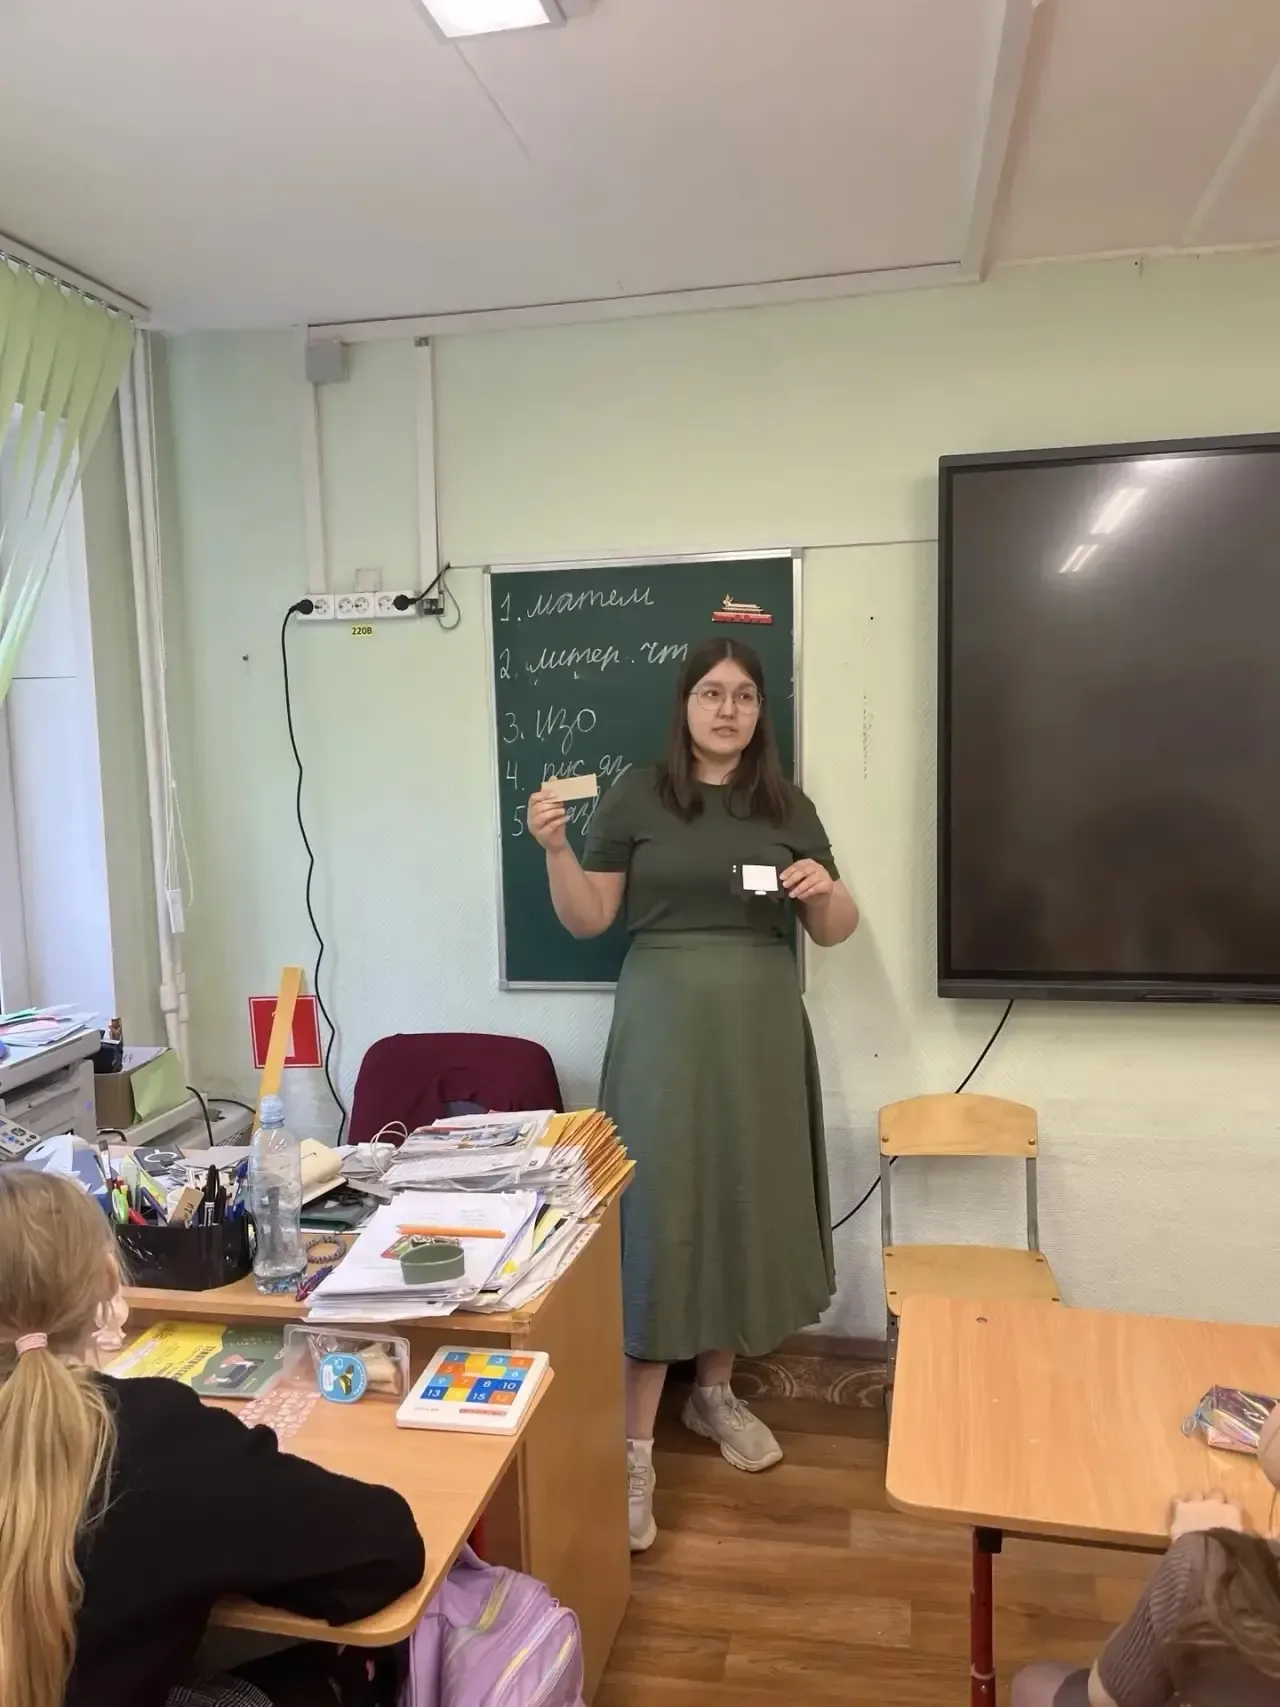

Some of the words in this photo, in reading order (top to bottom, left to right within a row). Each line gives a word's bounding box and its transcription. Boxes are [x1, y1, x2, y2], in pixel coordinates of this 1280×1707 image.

[500, 593, 522, 622] 1.
[526, 587, 655, 618] матем
[351, 626, 373, 636] 220В
[503, 711, 525, 744] 3.
[506, 762, 526, 791] 4.
[427, 1388, 442, 1397] 13
[473, 1392, 486, 1401] 15
[483, 1380, 492, 1388] 8
[503, 1382, 516, 1390] 10
